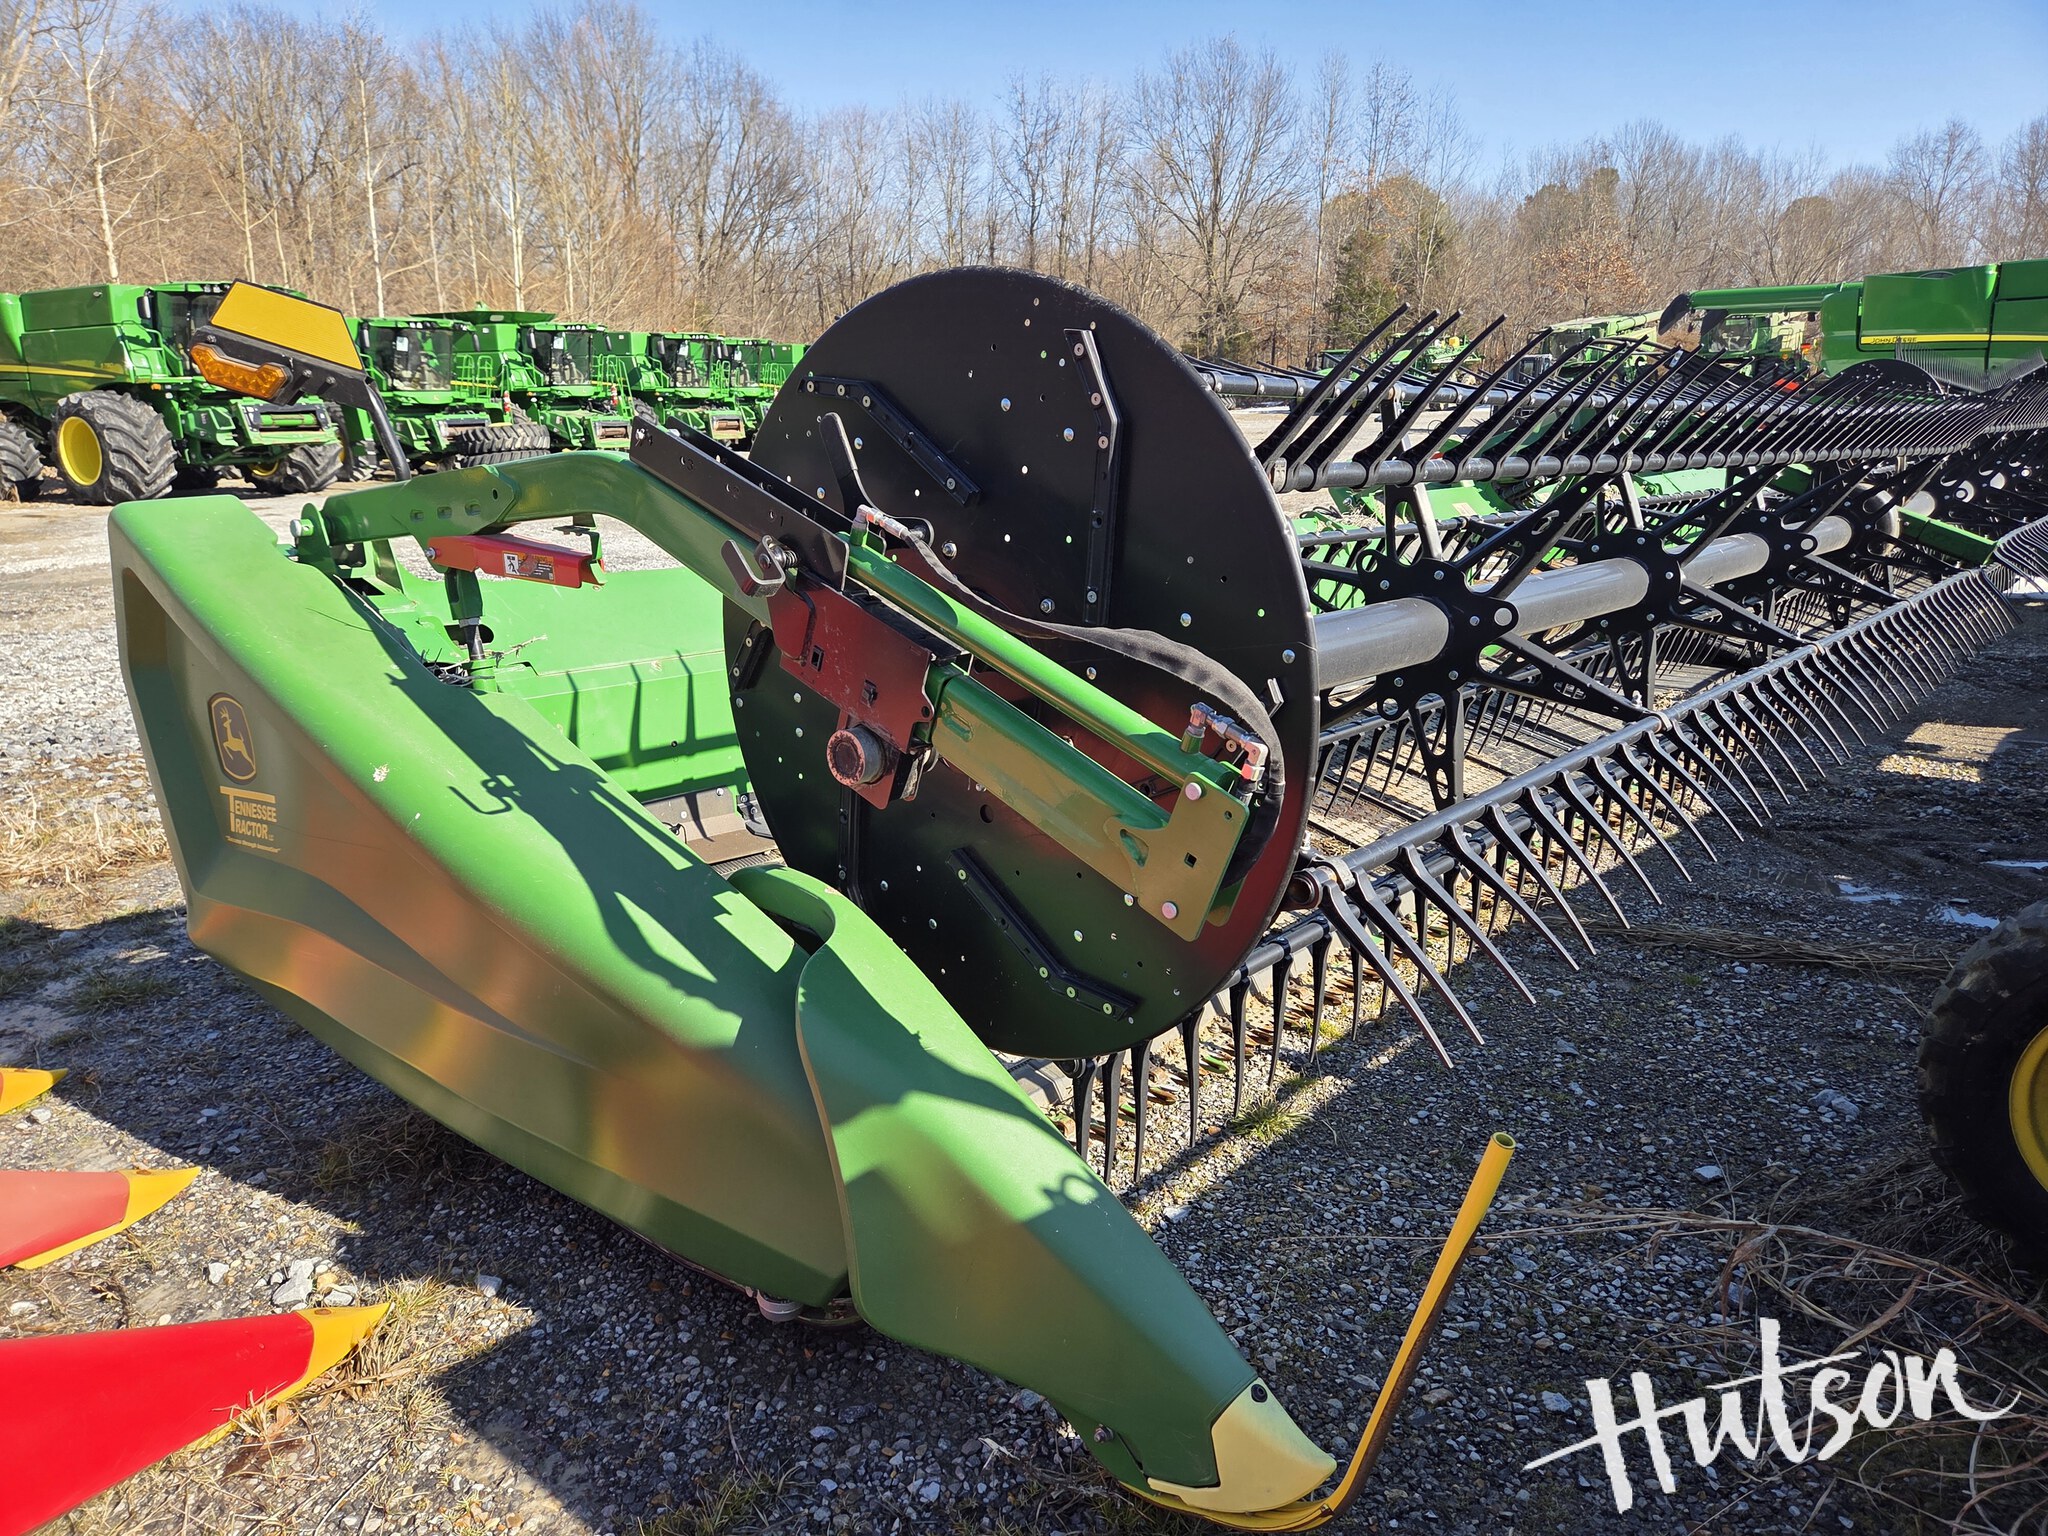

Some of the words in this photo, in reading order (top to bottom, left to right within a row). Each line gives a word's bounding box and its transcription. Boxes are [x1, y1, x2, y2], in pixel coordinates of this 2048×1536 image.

[686, 458, 694, 471] 3
[219, 785, 278, 823] TENNESSEE
[230, 812, 268, 840] TRACTOR
